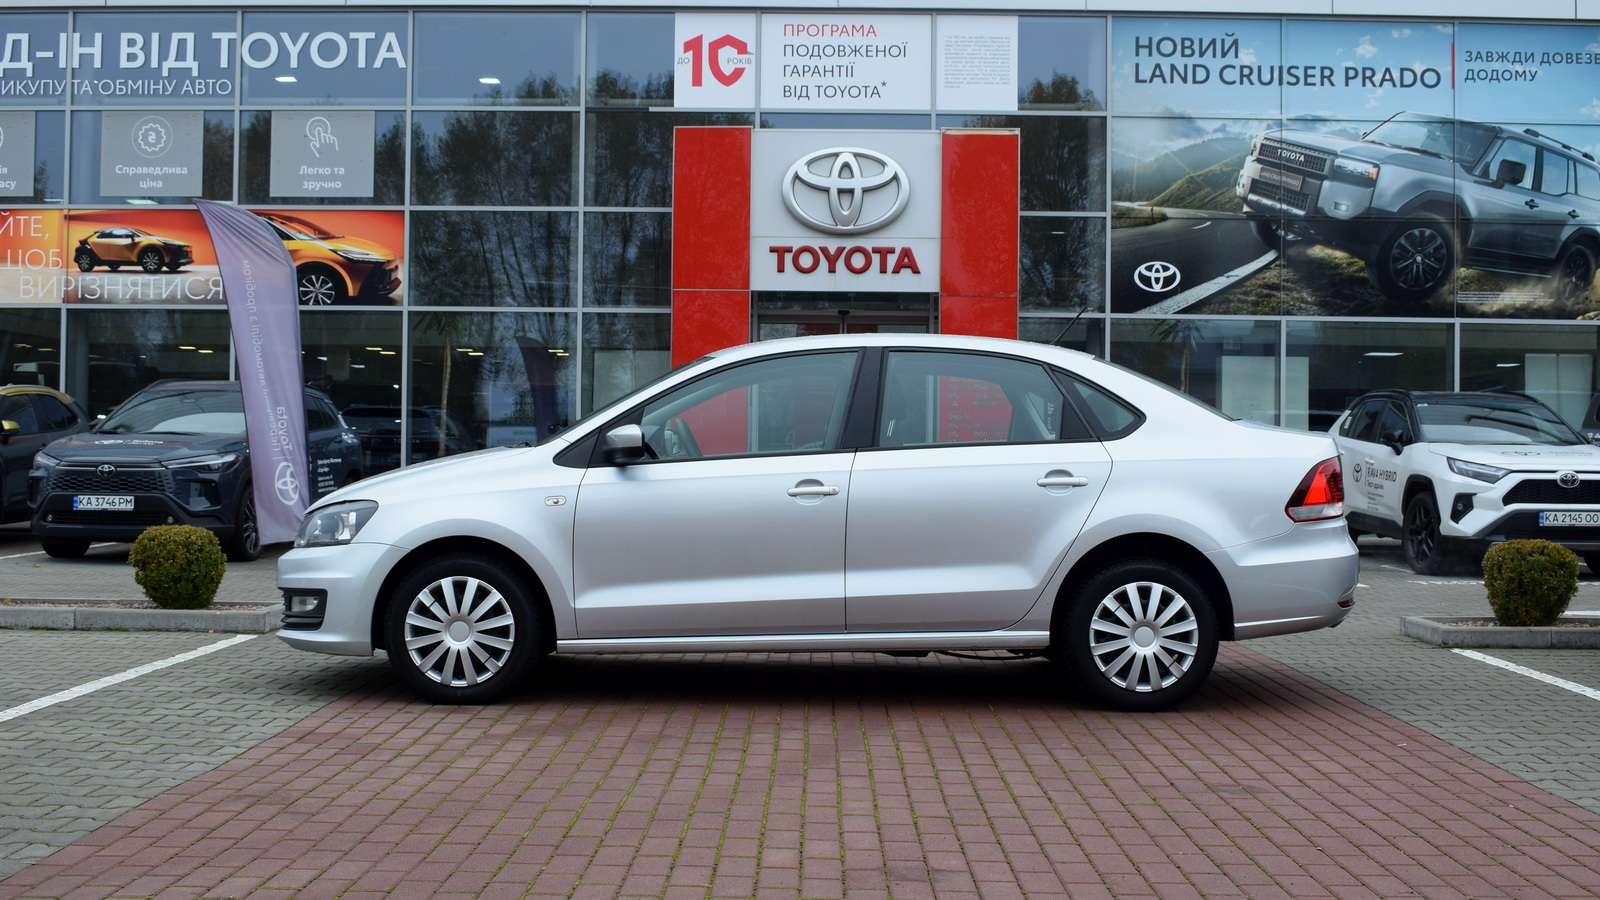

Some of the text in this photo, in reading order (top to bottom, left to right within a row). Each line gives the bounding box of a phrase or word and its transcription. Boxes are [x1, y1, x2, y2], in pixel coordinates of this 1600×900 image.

[783, 24, 877, 37] ПРОГРАМА
[783, 41, 908, 60] ПОДОВЖЕНОЇ
[1135, 32, 1239, 59] НОВИЙ
[119, 32, 199, 77] ВІД
[212, 31, 407, 69] TOYOTA
[677, 57, 690, 65] ДО
[727, 57, 753, 65] РОКІВ
[1464, 50, 1535, 65] ЗАВЖДИ
[783, 62, 856, 78] ГАРАНТІЇ
[1135, 62, 1441, 89] LAND CRUISER PRADO
[1464, 68, 1538, 83] ДОДОМУ
[72, 79, 93, 95] ТА
[98, 79, 177, 95] ОБМІНУ
[181, 79, 232, 95] АВТО
[783, 85, 811, 101] ВІД
[1277, 149, 1305, 162] TOYOTA
[115, 164, 188, 176] Справедлива
[299, 165, 345, 175] Легко та
[140, 178, 163, 189] ціна
[302, 181, 342, 191] зручно
[769, 245, 921, 275] TOYOTA
[20, 275, 223, 299] ВИРІЗНЯТИСЯ
[1379, 469, 1397, 482] HYBRID
[78, 497, 133, 507] KA 3746 PM
[1544, 513, 1559, 523] KA
[1561, 513, 1583, 523] 2145
